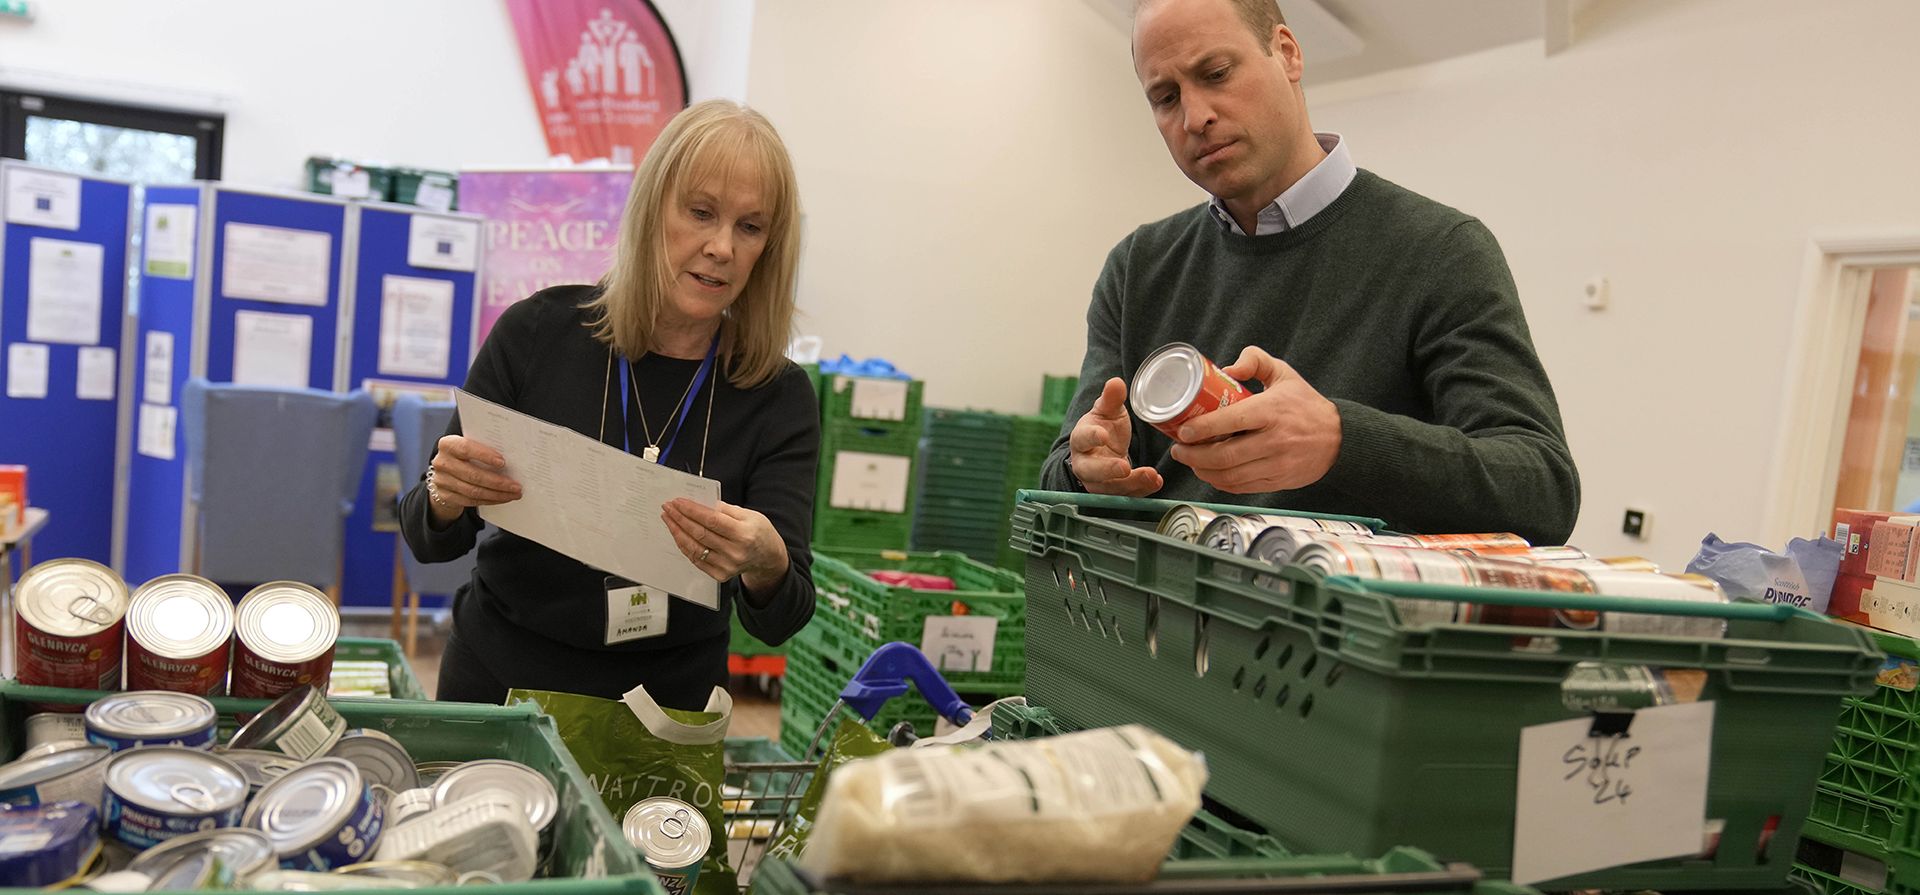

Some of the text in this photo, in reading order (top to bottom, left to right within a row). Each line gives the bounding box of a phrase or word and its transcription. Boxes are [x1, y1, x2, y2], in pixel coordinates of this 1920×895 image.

[485, 218, 610, 251] PEACE
[529, 255, 563, 273] ON
[1774, 577, 1800, 591] Scottish
[616, 625, 648, 637] AMANDA
[27, 631, 88, 653] GLENRYCK
[140, 654, 199, 673] GLENRYCK
[244, 653, 298, 678] GLENRYCK
